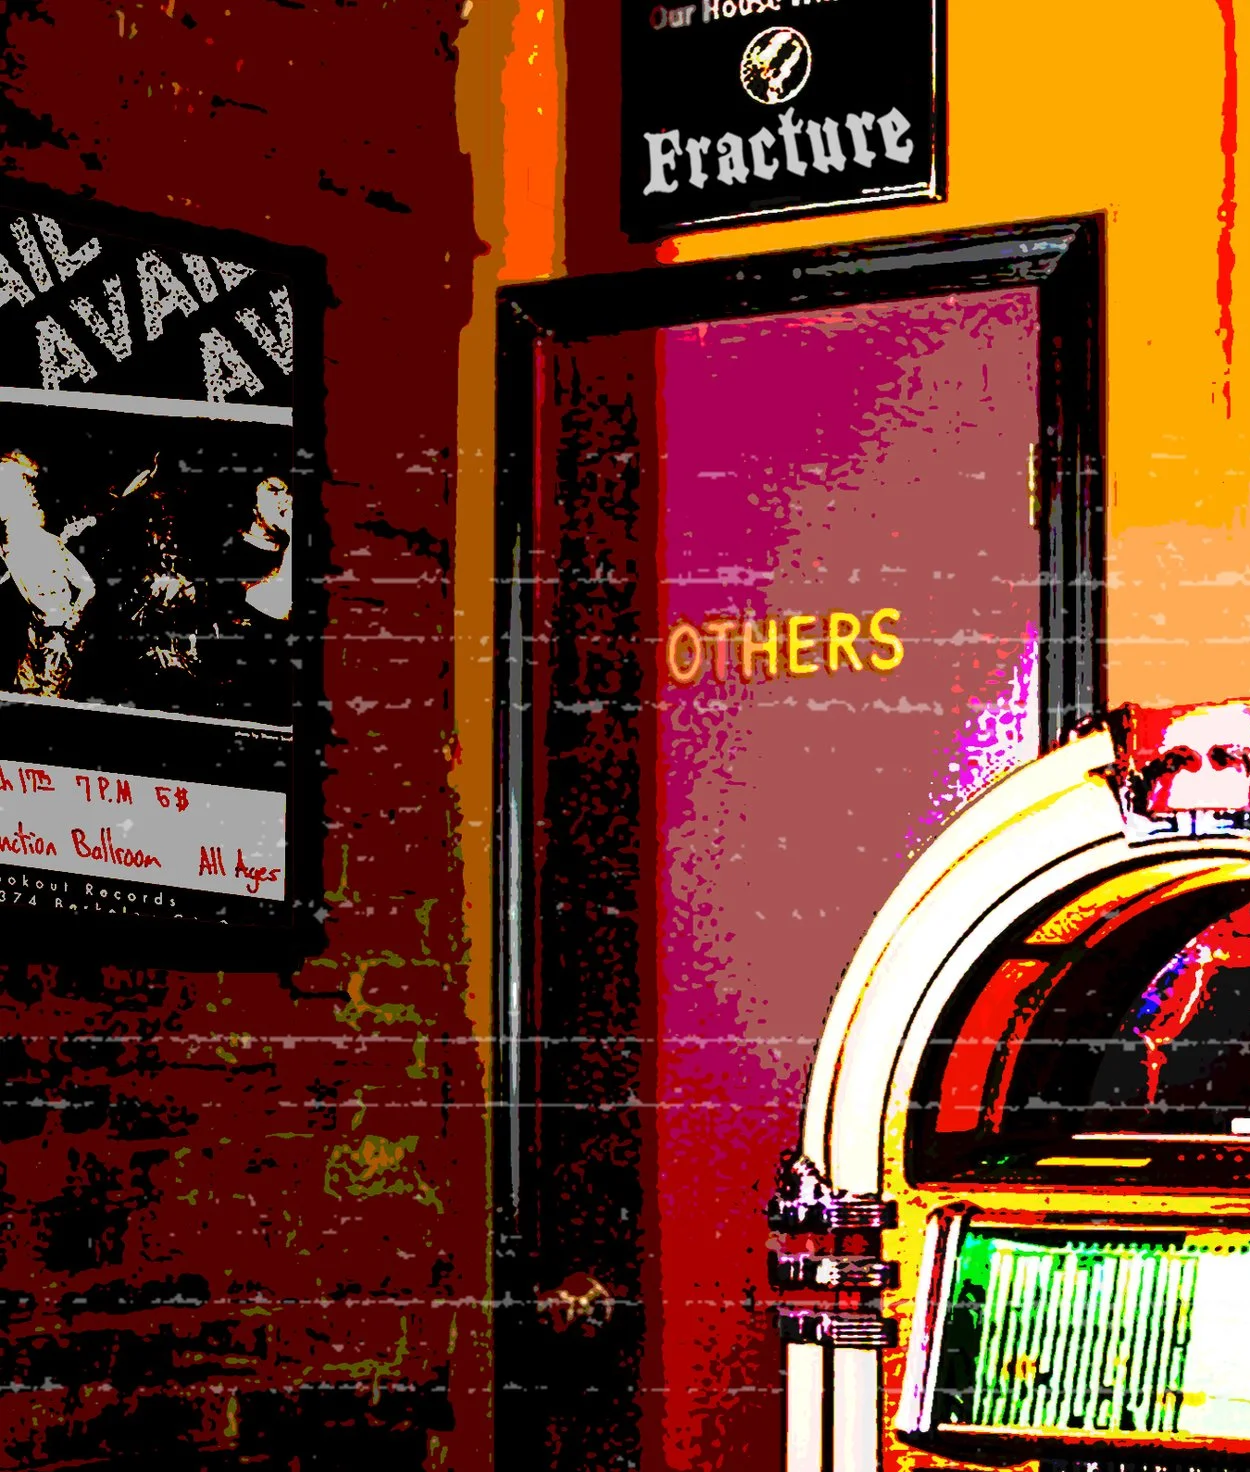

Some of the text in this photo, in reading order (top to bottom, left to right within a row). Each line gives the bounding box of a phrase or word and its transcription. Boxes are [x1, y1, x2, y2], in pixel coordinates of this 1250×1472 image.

[650, 4, 697, 30] Our
[643, 106, 914, 196] Fracture
[669, 607, 904, 684] OTHERS
[76, 775, 91, 802] 7
[71, 827, 162, 868] Ballroom
[199, 846, 227, 877] All
[234, 848, 282, 894] Ages
[0, 873, 176, 907] okout Records
